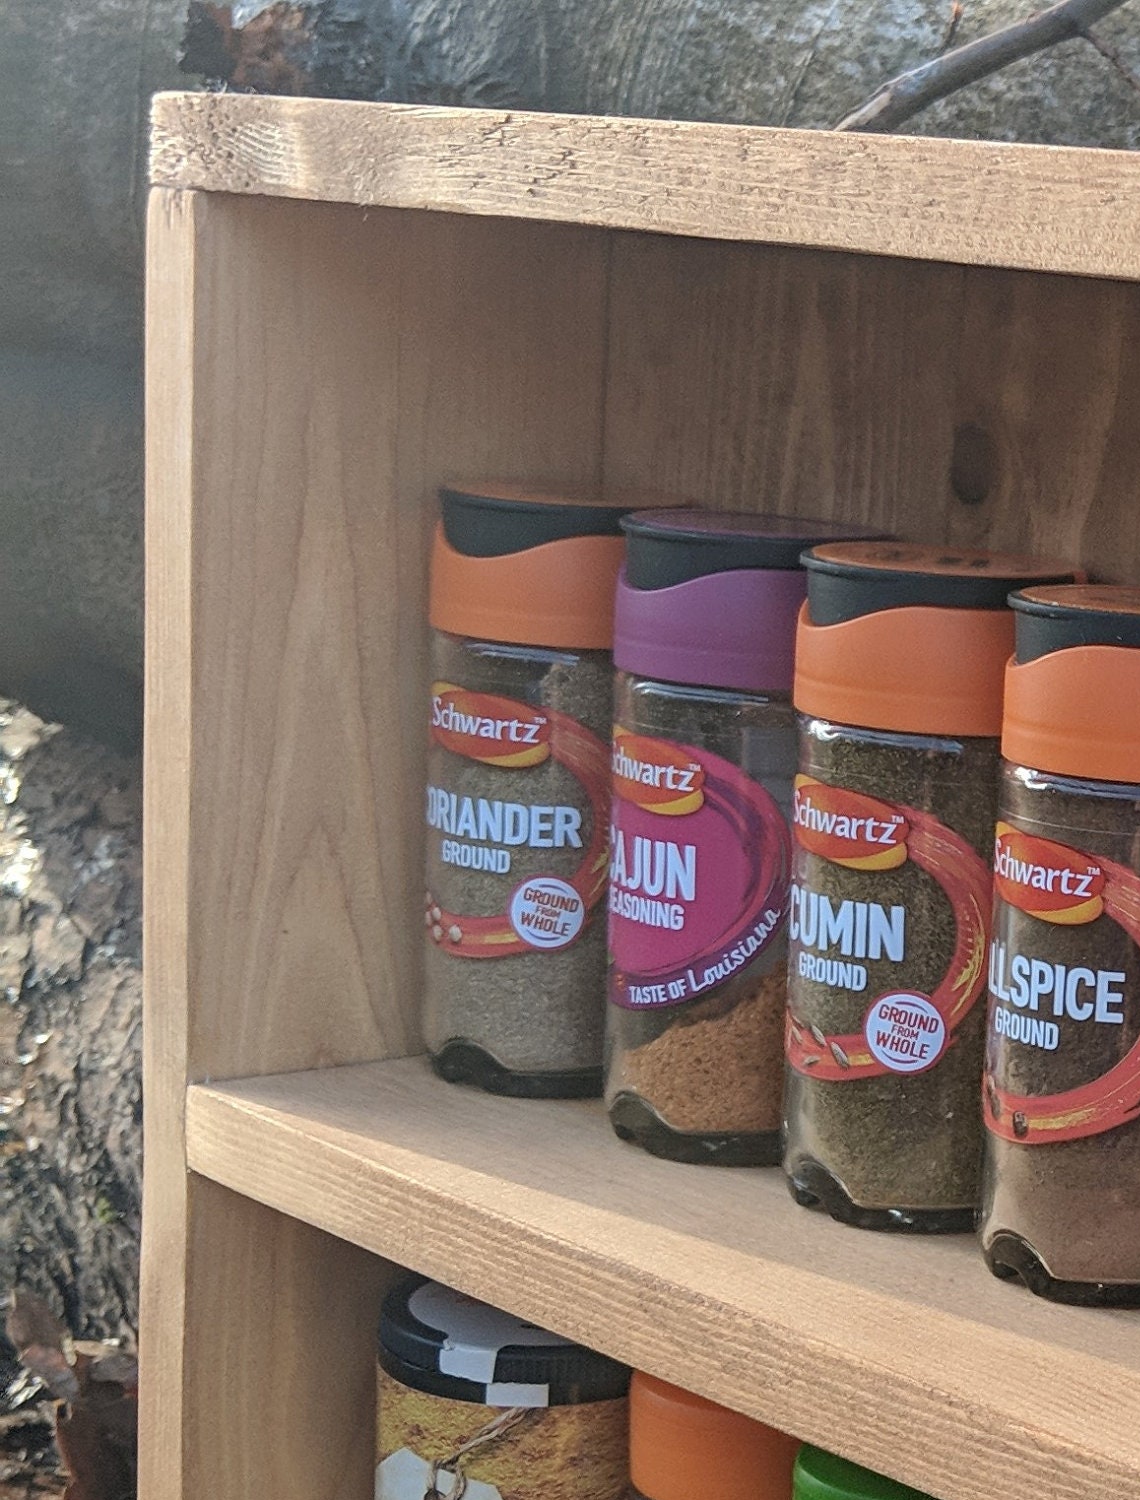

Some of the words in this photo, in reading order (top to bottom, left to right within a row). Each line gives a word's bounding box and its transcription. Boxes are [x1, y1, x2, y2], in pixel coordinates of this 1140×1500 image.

[432, 695, 542, 744] Schwartz
[426, 786, 584, 849] ORIANDER
[793, 788, 897, 845] Schwartz
[441, 839, 512, 875] GROUND
[609, 823, 697, 902] AJUN
[993, 840, 1093, 899] Schwartz
[523, 886, 580, 914] GROUND
[534, 904, 561, 919] FROM
[609, 885, 685, 931] EASONING
[789, 883, 906, 963] CUMIN
[519, 910, 572, 937] WHOLE
[629, 984, 668, 1005] TASTE
[669, 978, 687, 998] OF
[687, 907, 782, 993] Louisiana
[798, 953, 868, 993] GROUND
[988, 940, 1127, 1025] LLSPICE
[878, 1003, 940, 1034] GROUND
[890, 1023, 919, 1041] FROM
[994, 1005, 1060, 1051] GROUND
[875, 1029, 931, 1060] WHOLE
